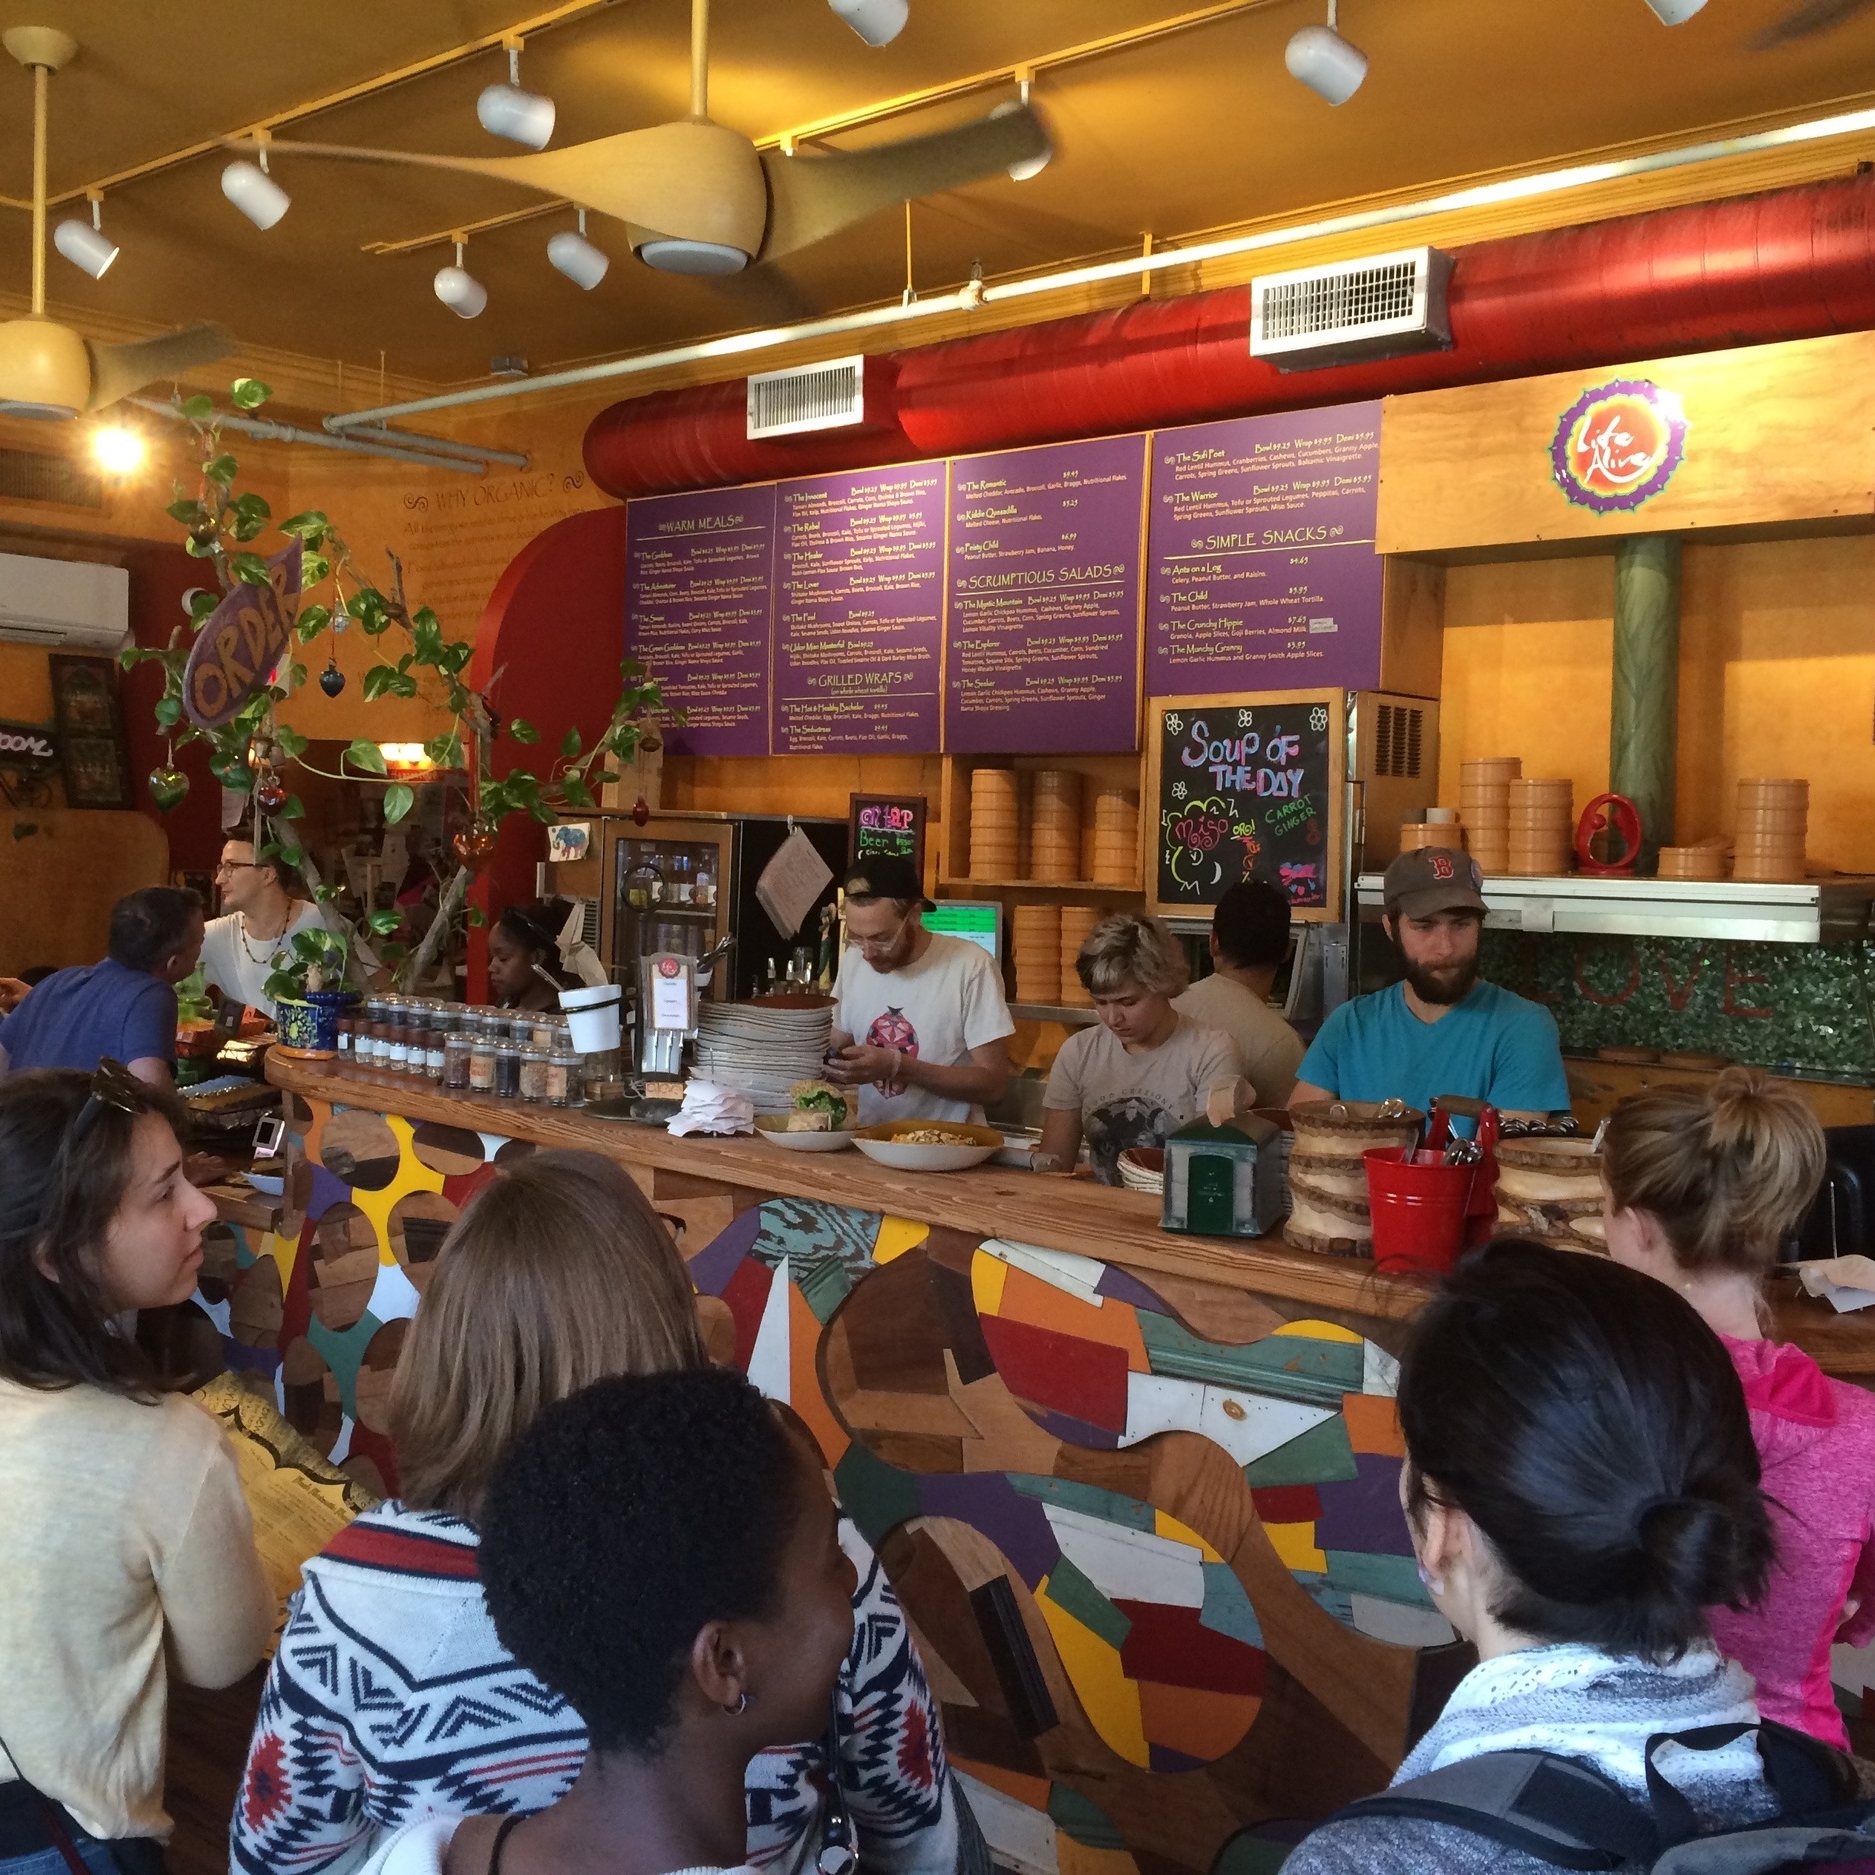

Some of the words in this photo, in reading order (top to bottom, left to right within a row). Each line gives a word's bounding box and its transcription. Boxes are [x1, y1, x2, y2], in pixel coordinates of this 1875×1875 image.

[1255, 442, 1272, 453] Bowl
[1294, 439, 1312, 449] Wrap
[1176, 452, 1191, 463] The
[1176, 464, 1186, 472] Red
[966, 482, 979, 491] The
[1254, 484, 1270, 495] Bowl
[1292, 481, 1310, 491] Wrap
[793, 493, 804, 502] The
[1174, 492, 1190, 504] The
[1191, 491, 1218, 502] Warrior
[666, 519, 695, 533] WARM
[698, 515, 735, 528] MEALS
[792, 524, 804, 533] The
[1206, 532, 1256, 549] SIMPLE
[1262, 526, 1327, 545] SNACKS
[792, 553, 804, 562] The
[1172, 565, 1190, 575] Ants
[1206, 562, 1222, 573] Log
[968, 570, 1055, 589] SCRUMPTIOUS
[1059, 564, 1112, 581] SALADS
[791, 581, 803, 590] The
[1171, 593, 1187, 603] The
[1188, 591, 1208, 602] Child
[1280, 597, 1300, 605] Wheat
[963, 600, 976, 610] The
[1171, 621, 1186, 631] The
[1187, 619, 1217, 630] Crunchy
[1218, 617, 1243, 630] Hippie
[1268, 626, 1292, 635] Almond
[962, 640, 974, 650] The
[1170, 644, 1185, 655] The
[1186, 643, 1214, 655] Munchy
[1215, 642, 1242, 653] Granny
[1286, 651, 1305, 659] Apple
[818, 674, 863, 687] GRILLED
[865, 672, 902, 684] WRAPS
[962, 680, 974, 689] The
[1208, 764, 1256, 791] THE
[1256, 768, 1304, 798] DAY
[1264, 792, 1312, 824] CARROT
[1274, 806, 1317, 836] GINGER
[1428, 856, 1454, 880] B
